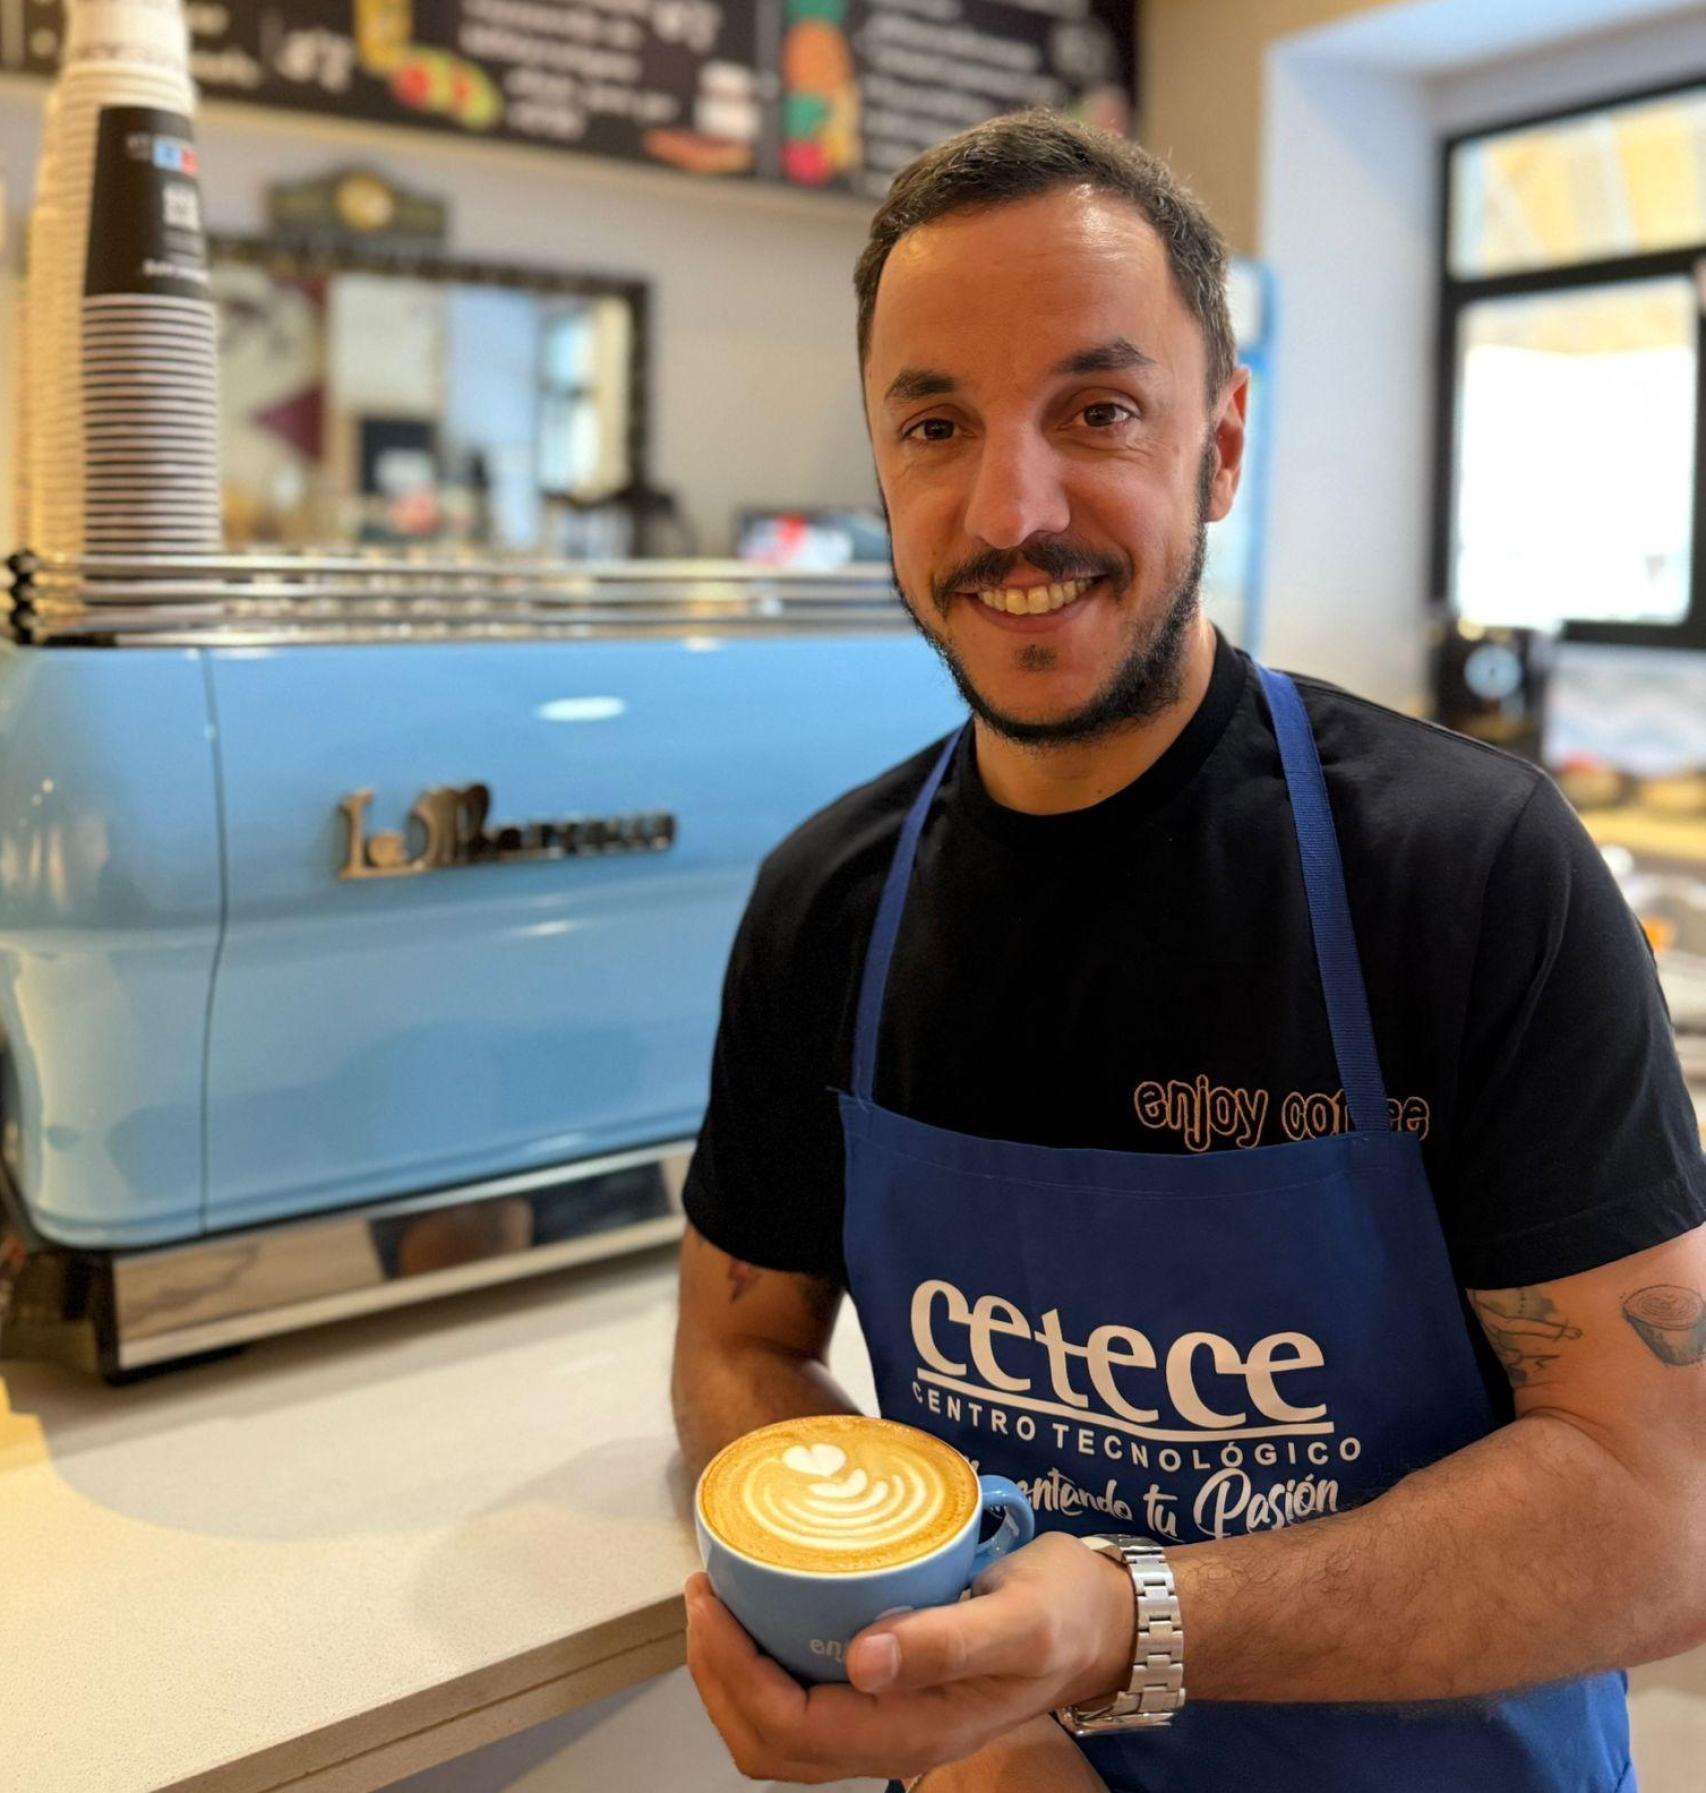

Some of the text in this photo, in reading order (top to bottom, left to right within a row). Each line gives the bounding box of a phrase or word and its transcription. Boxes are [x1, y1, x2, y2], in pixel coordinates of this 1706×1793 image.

[1134, 1074, 1430, 1152] enjoy coee
[911, 1279, 1328, 1429] cetece
[912, 1381, 1362, 1472] CENTRO TECNOLÓGICO
[1143, 1483, 1185, 1543] tu
[1193, 1467, 1339, 1539] Pasión
